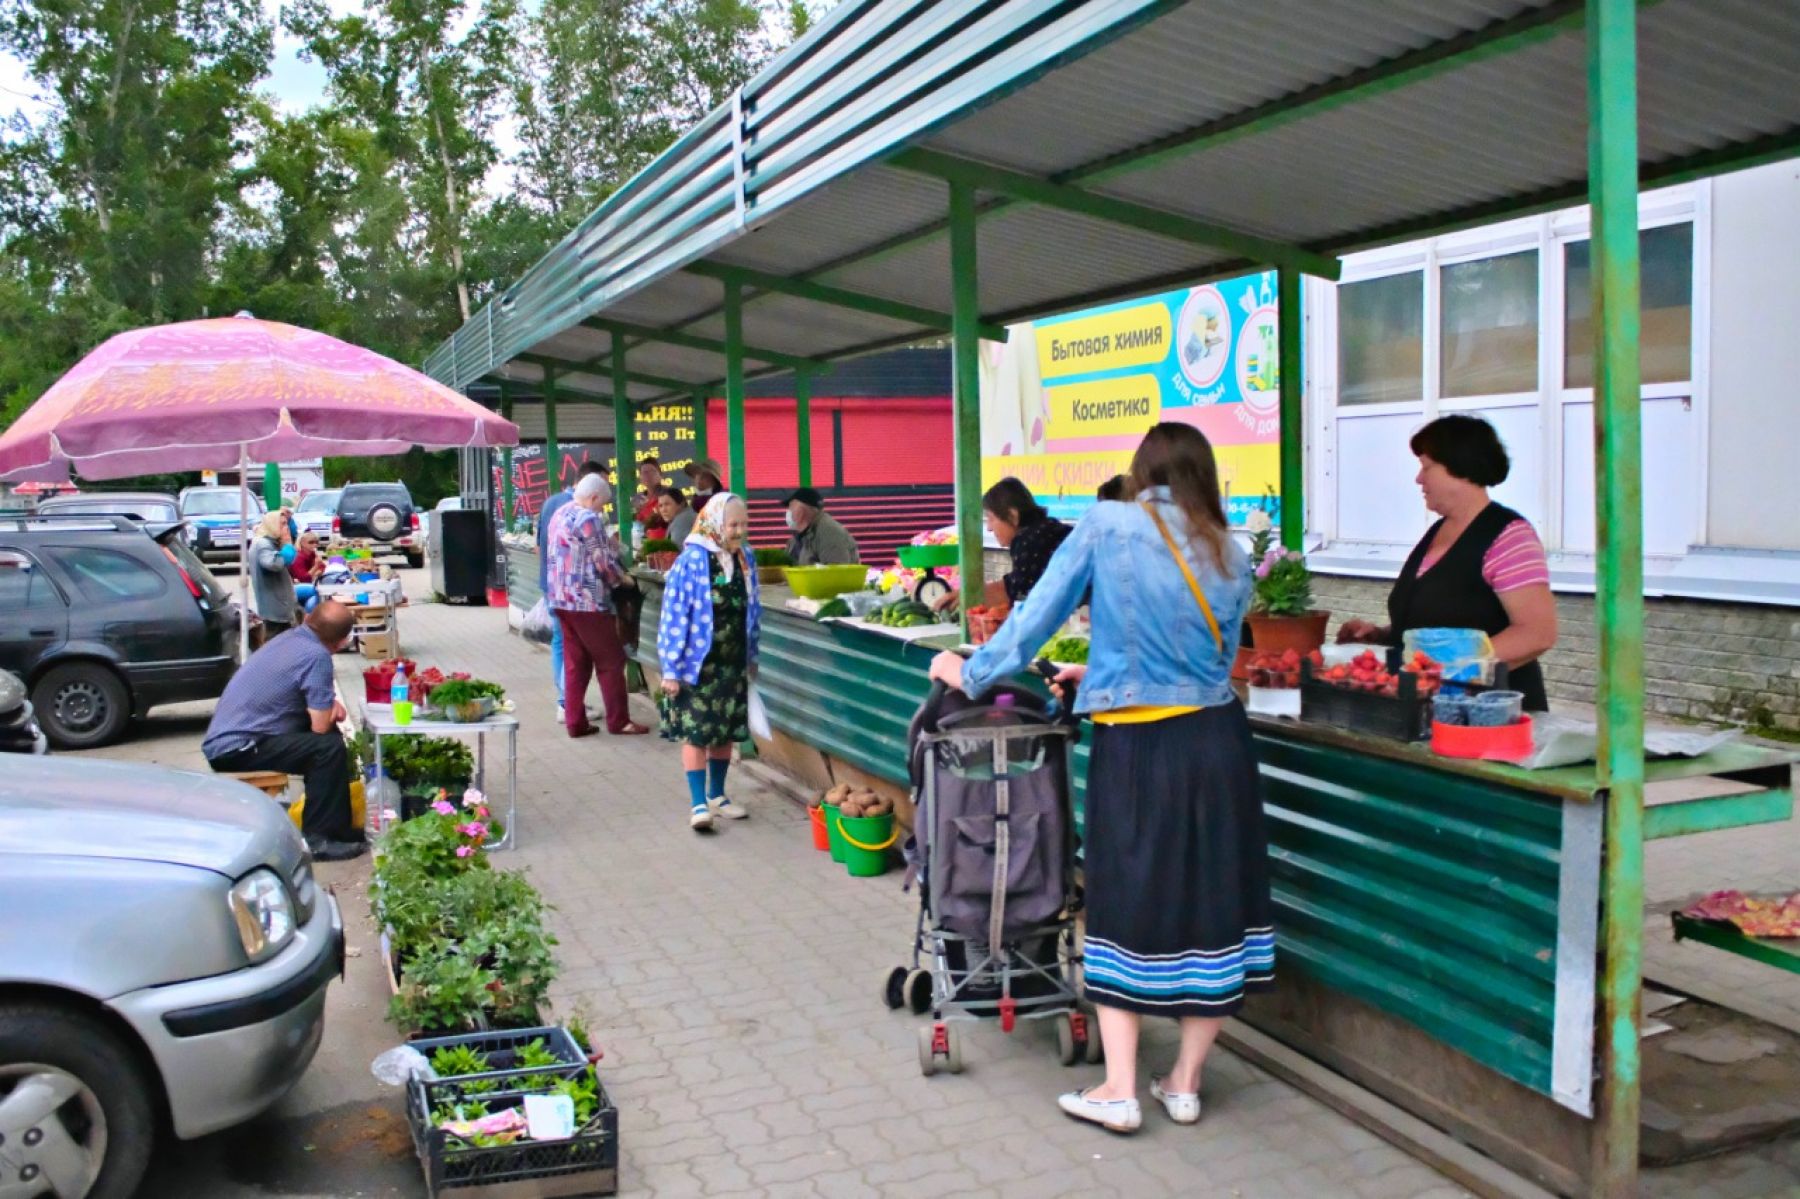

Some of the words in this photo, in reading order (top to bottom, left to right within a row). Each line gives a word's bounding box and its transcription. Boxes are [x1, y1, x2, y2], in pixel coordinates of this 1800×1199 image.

[1052, 336, 1110, 361] Бытовая
[1114, 326, 1162, 351] химия
[1073, 399, 1150, 421] Косметика
